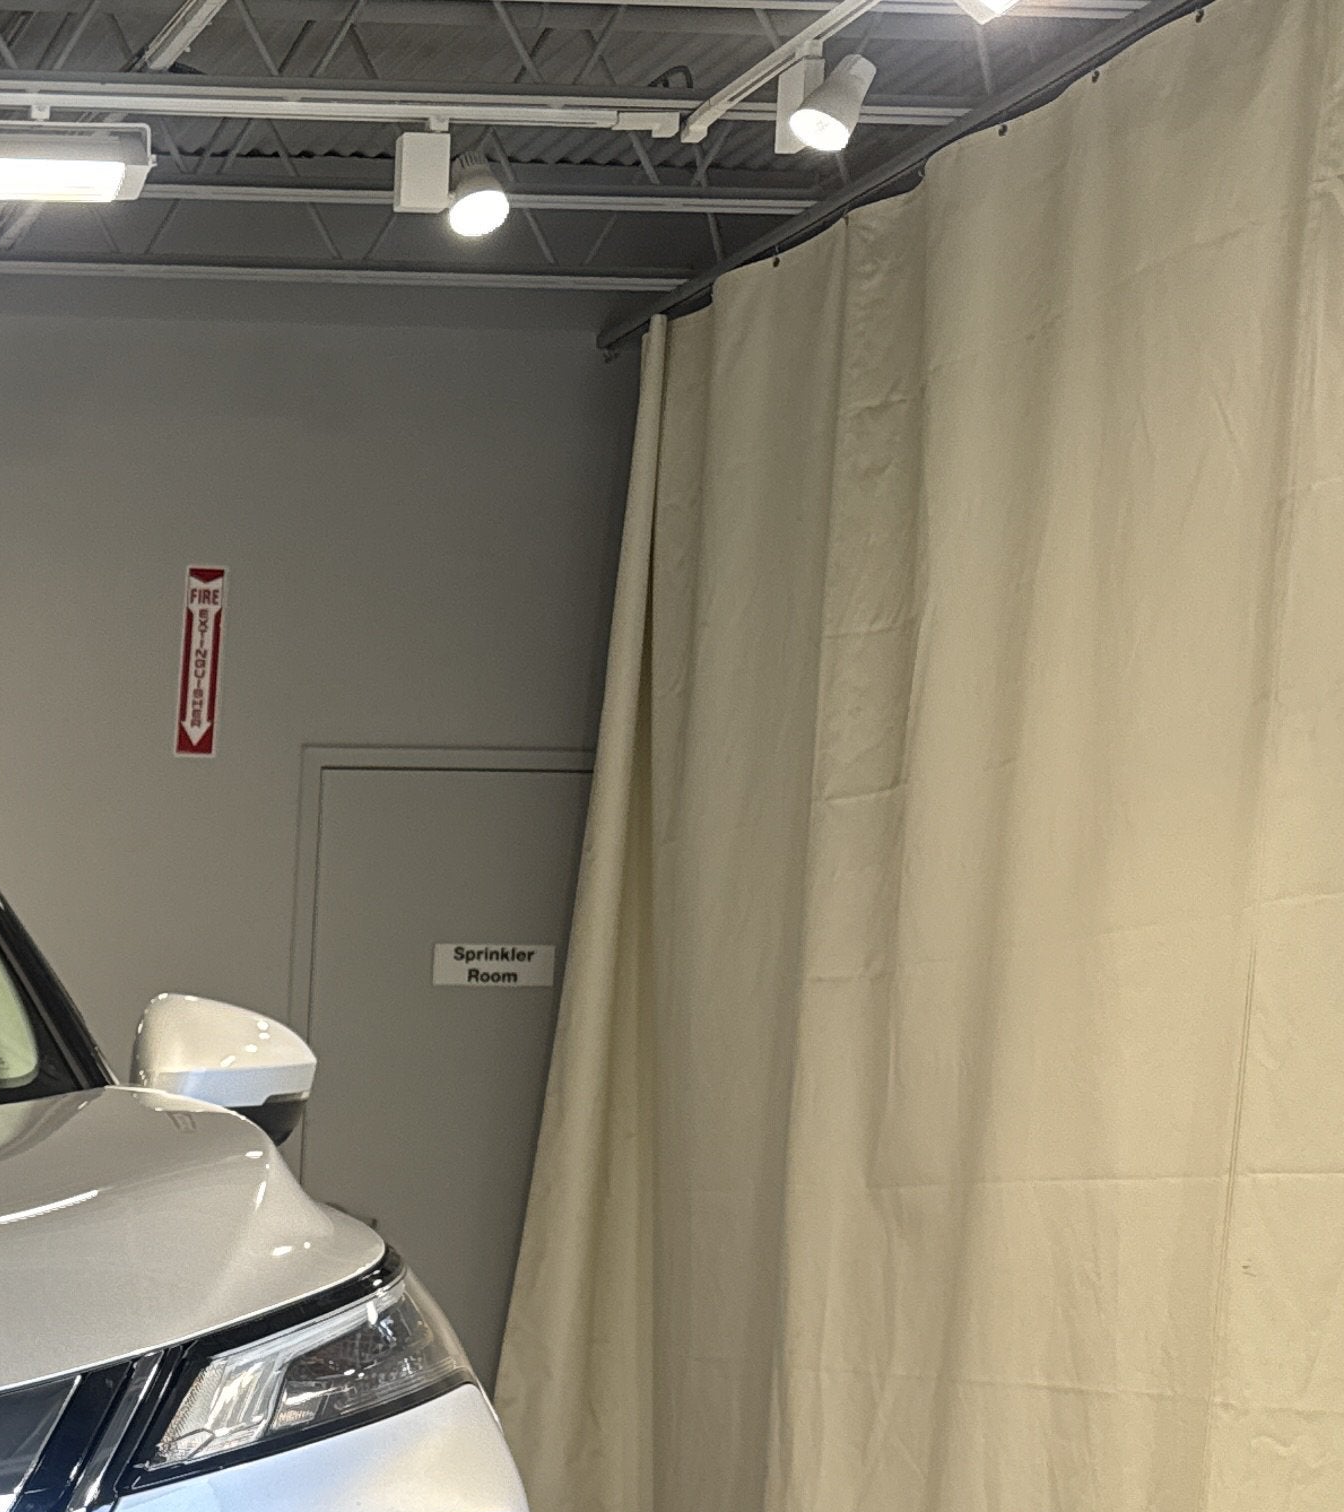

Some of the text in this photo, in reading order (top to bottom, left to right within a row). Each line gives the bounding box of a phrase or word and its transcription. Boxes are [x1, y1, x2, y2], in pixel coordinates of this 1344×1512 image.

[189, 588, 219, 605] FIRE
[191, 609, 208, 728] EXTINGUISHER
[453, 946, 535, 963] Sprinkler
[467, 968, 518, 983] Room
